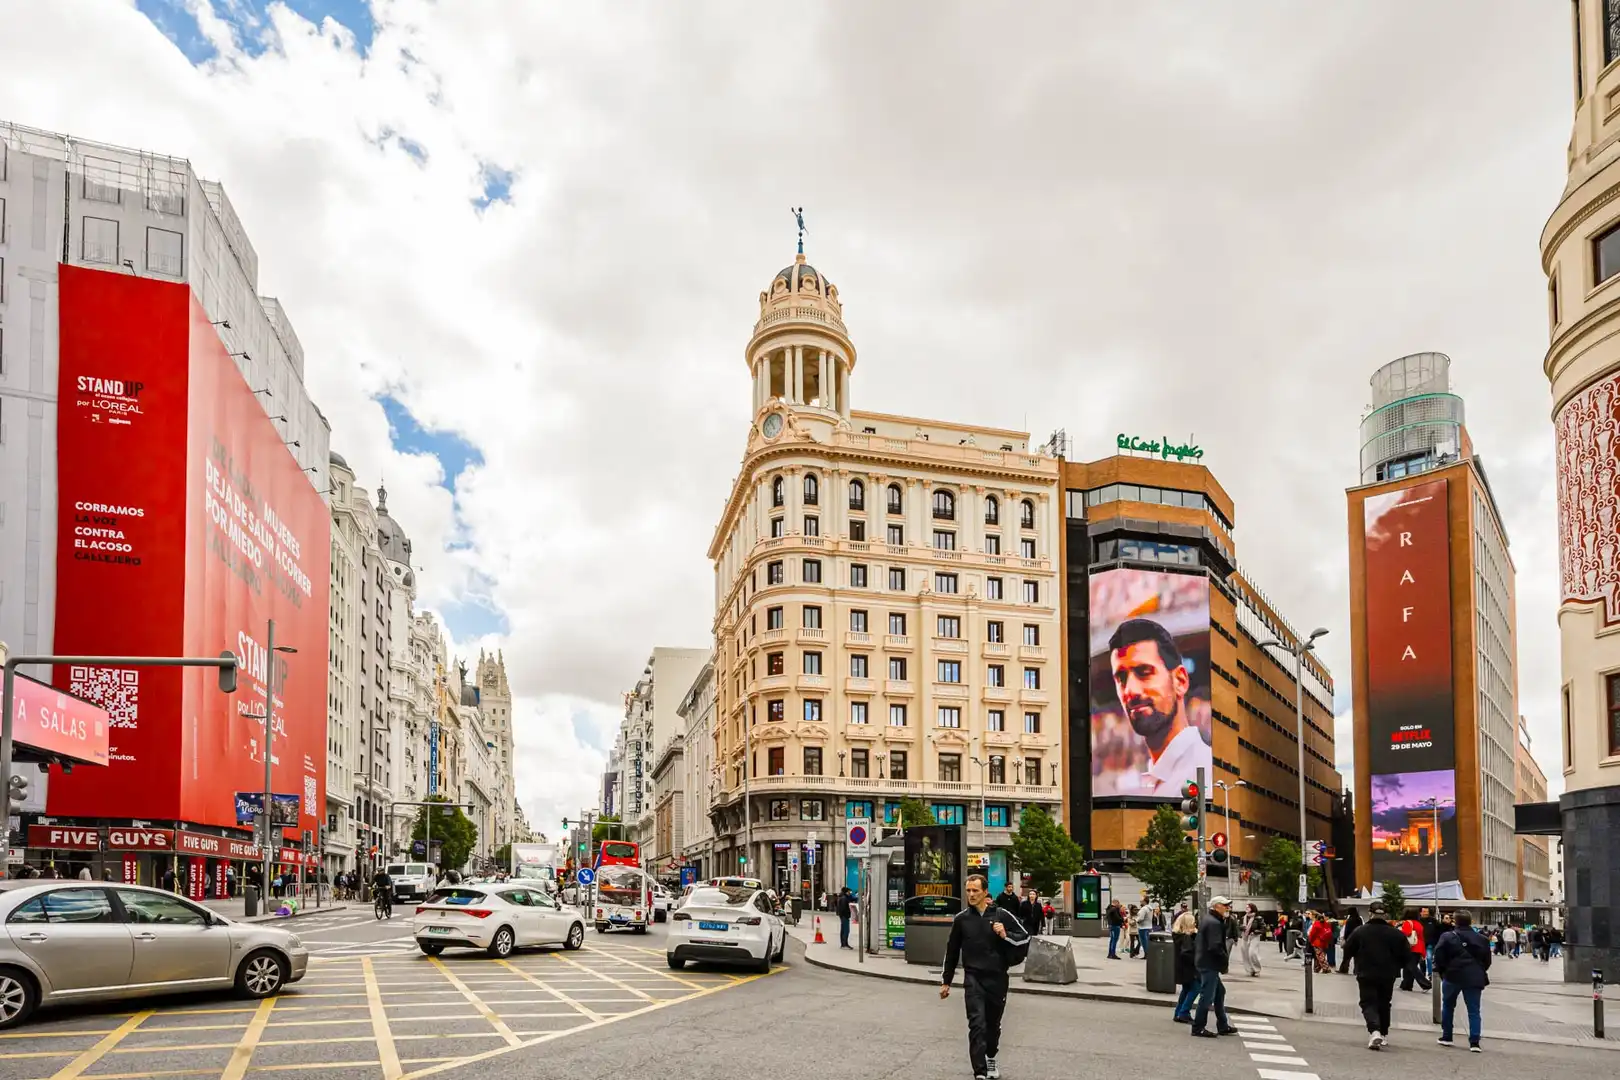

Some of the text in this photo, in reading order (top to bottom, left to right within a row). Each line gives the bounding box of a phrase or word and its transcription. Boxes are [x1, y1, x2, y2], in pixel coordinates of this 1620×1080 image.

[1117, 433, 1130, 449] El
[1130, 436, 1160, 453] Corte
[75, 501, 145, 517] CORRAMOS
[75, 514, 117, 525] LA VOZ
[206, 456, 312, 598] DEJA DE SALIR A CORRER
[74, 526, 125, 539] CONTRA
[205, 489, 228, 535] POR
[229, 517, 262, 568] MIEDO
[264, 502, 300, 560] MUJERES
[74, 539, 132, 552] EL ACOSO
[74, 551, 142, 566] CALLEJERO
[40, 706, 87, 740] SALAS
[1391, 729, 1431, 742] NETFLIX
[51, 831, 166, 846] FIVE GUYS
[183, 836, 218, 851] FIVE GUYS
[230, 842, 243, 855] FIVE
